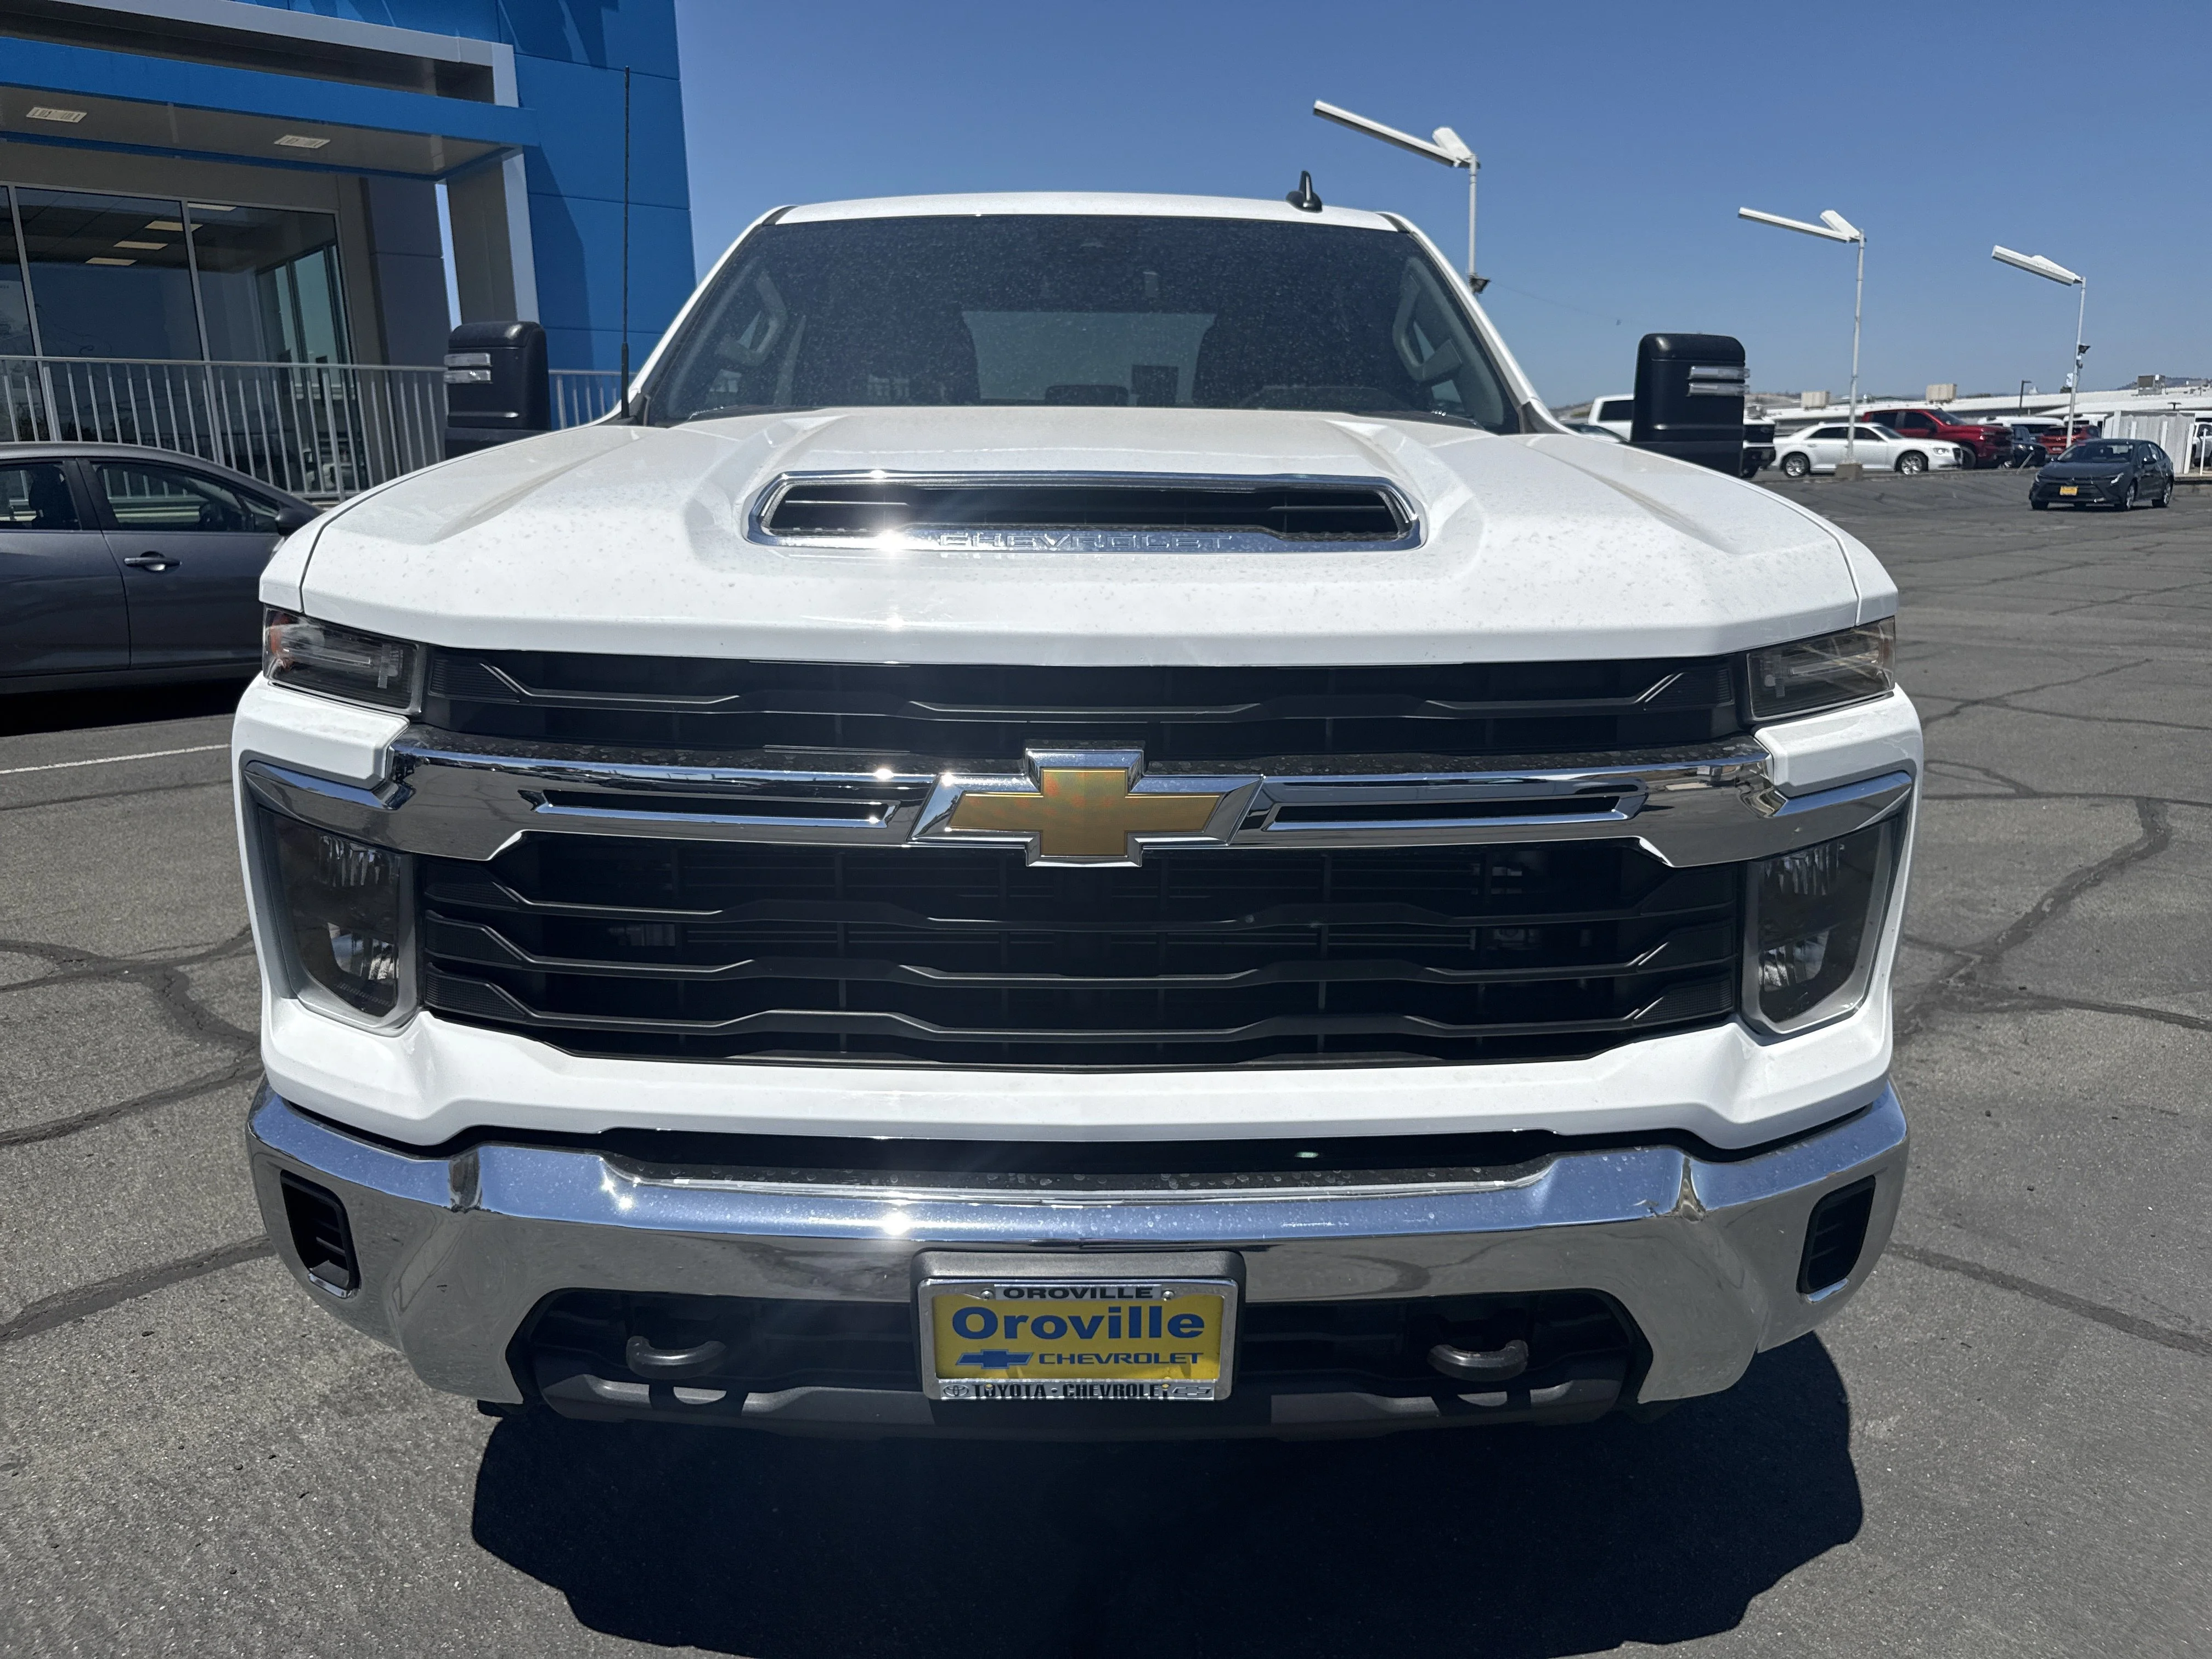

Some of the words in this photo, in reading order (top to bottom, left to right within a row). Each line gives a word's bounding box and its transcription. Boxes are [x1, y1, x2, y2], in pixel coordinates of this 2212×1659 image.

[939, 533, 1233, 549] CHEVROLET
[1003, 1286, 1153, 1299] OROVILLE
[952, 1306, 1205, 1339] Oroville
[1039, 1352, 1204, 1364] CHEVROLET
[972, 1383, 1046, 1398] TOYOTA
